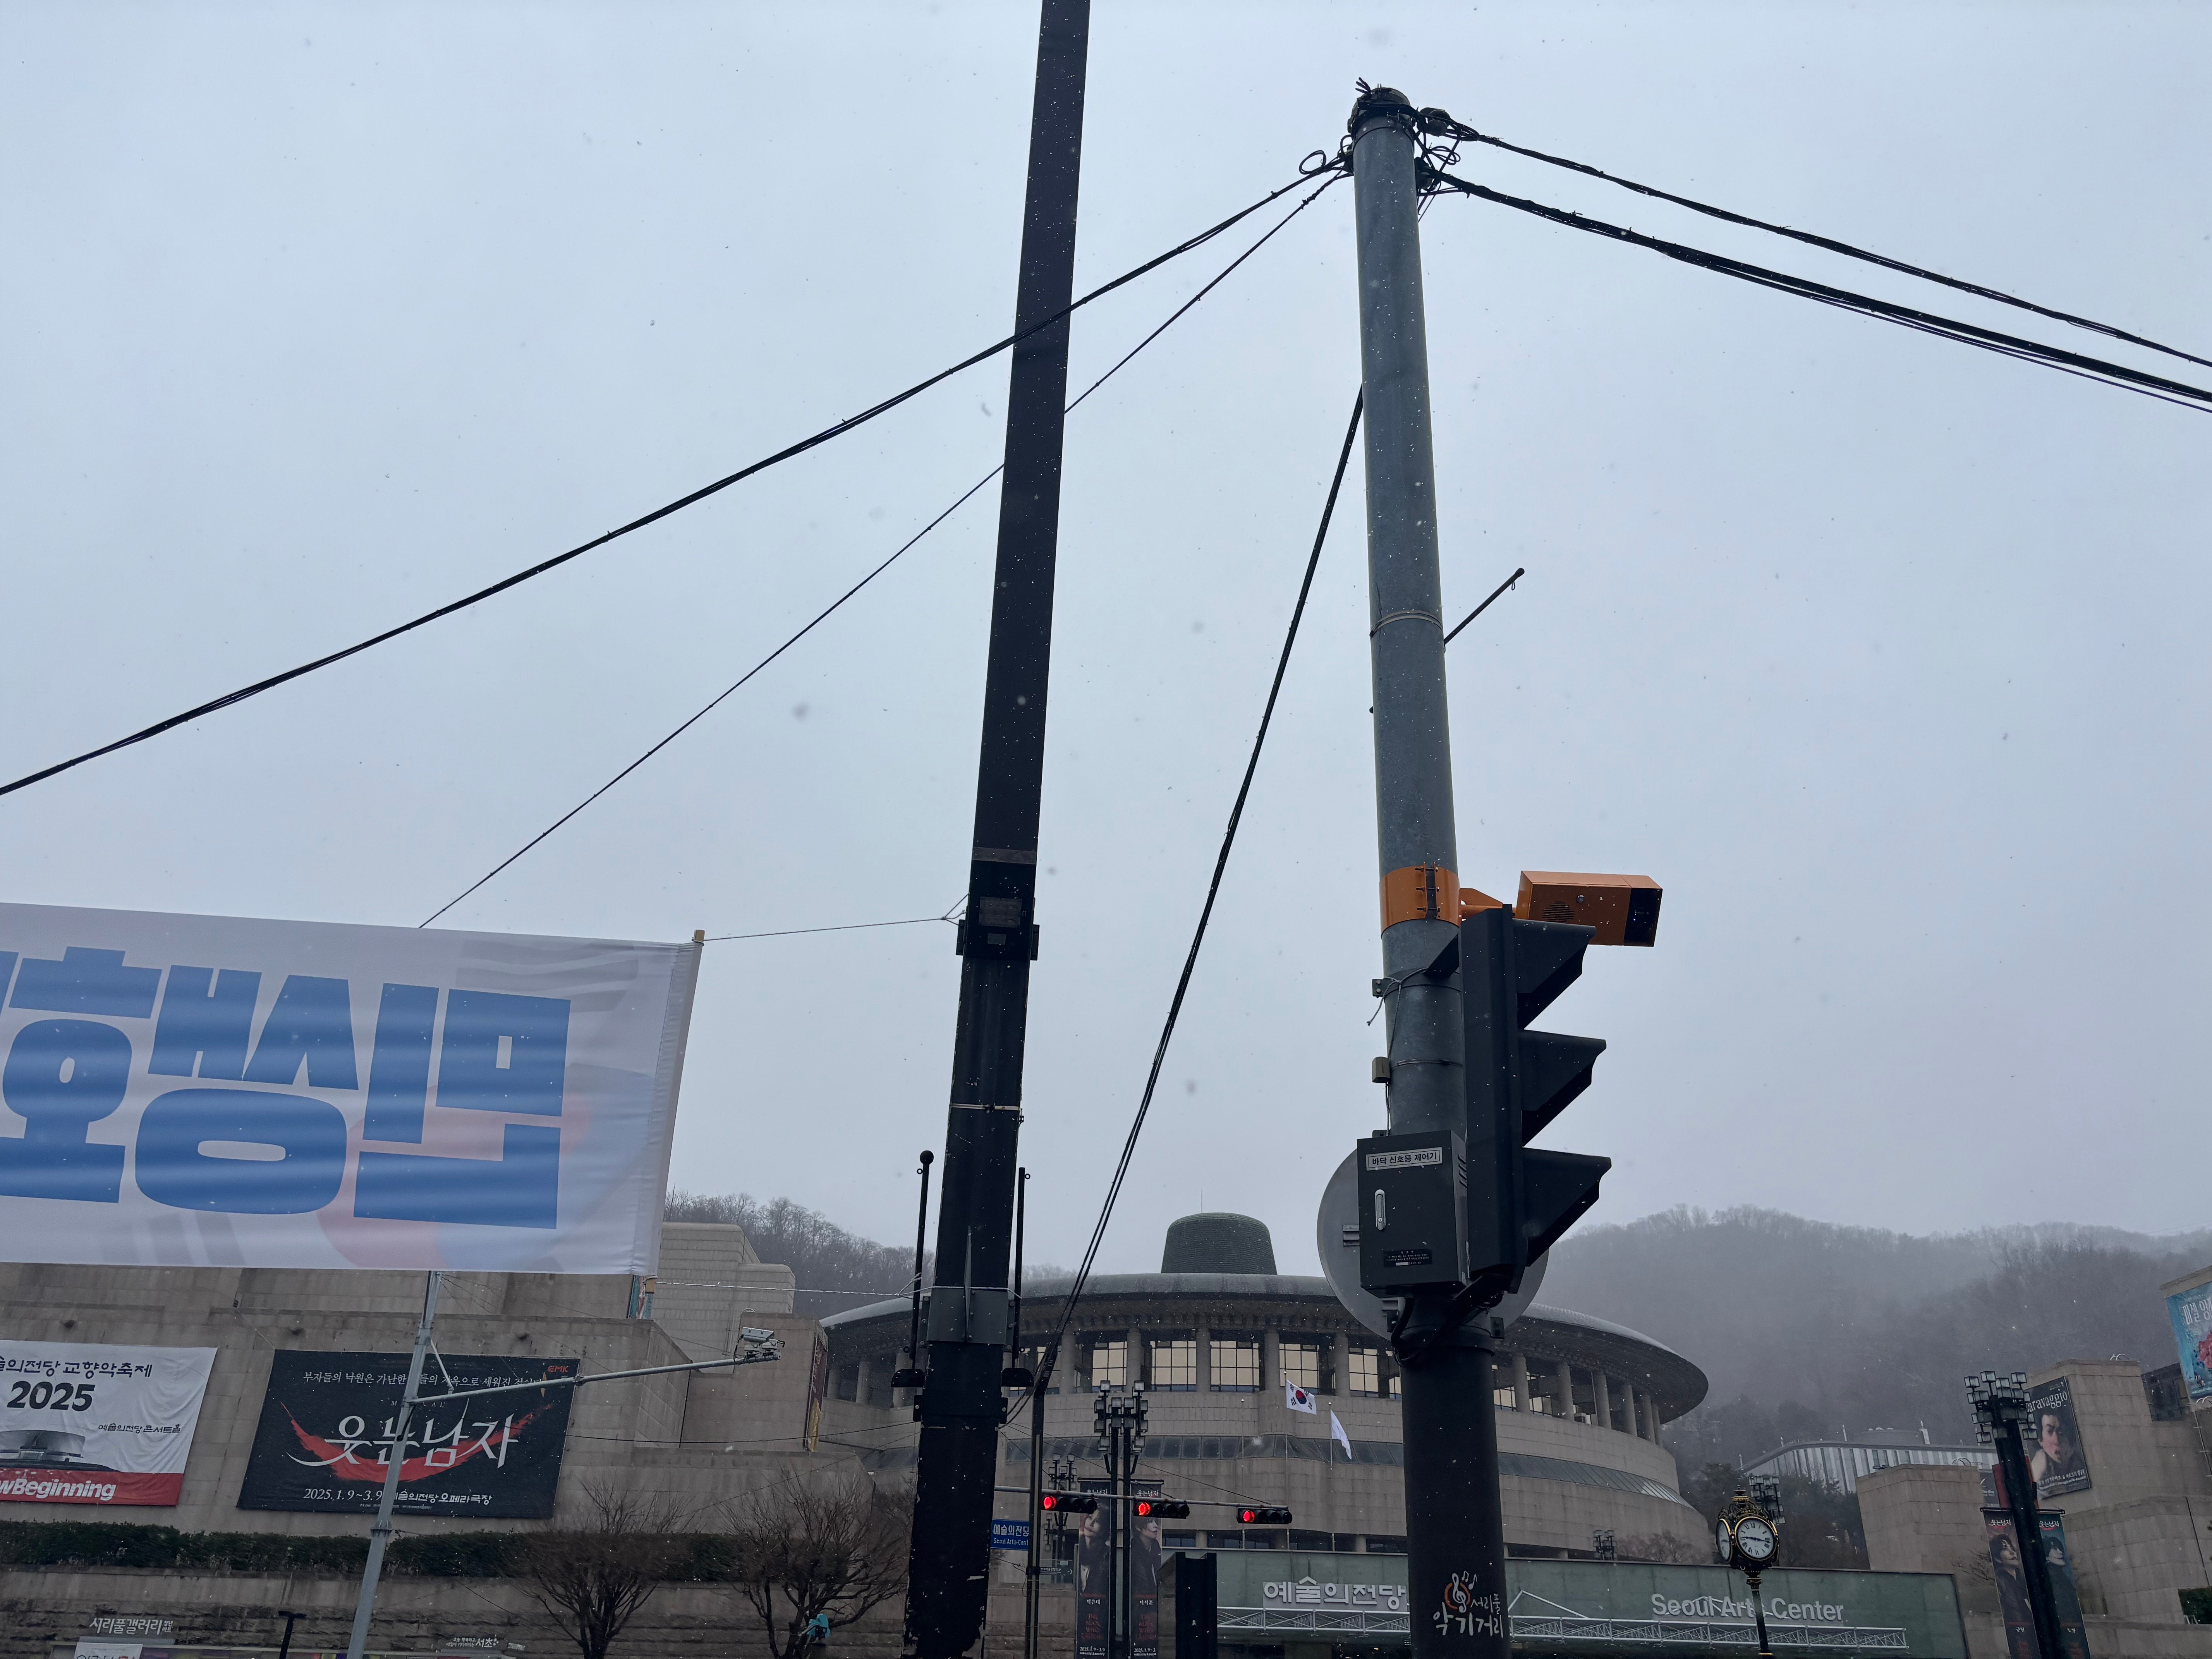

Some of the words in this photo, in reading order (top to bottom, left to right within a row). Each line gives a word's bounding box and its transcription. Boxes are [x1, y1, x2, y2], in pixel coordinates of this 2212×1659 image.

[1372, 1157, 1387, 1165] 바닥
[1389, 1155, 1412, 1164] 신호등
[1415, 1152, 1437, 1161] 제어기
[63, 1361, 152, 1379] 교향악축제
[303, 1371, 342, 1383] 부자들의
[346, 1372, 374, 1384] 낙원은
[376, 1374, 407, 1385] 가난한
[420, 1373, 438, 1386] 들의
[7, 1381, 96, 1412] 2025
[98, 1423, 143, 1434] 예술의전당
[143, 1424, 181, 1433] 콘서트홀
[395, 1490, 439, 1503] 술의전당
[438, 1493, 493, 1505] 오페라극장
[993, 1524, 1029, 1537] 예술의전당
[1264, 1576, 1406, 1610] 예술의전당
[1470, 1593, 1500, 1614] 서리풀
[1650, 1593, 1714, 1617] Seoul
[1721, 1596, 1766, 1618] Art
[1771, 1597, 1844, 1621] Center
[1433, 1602, 1503, 1638] 악기거리
